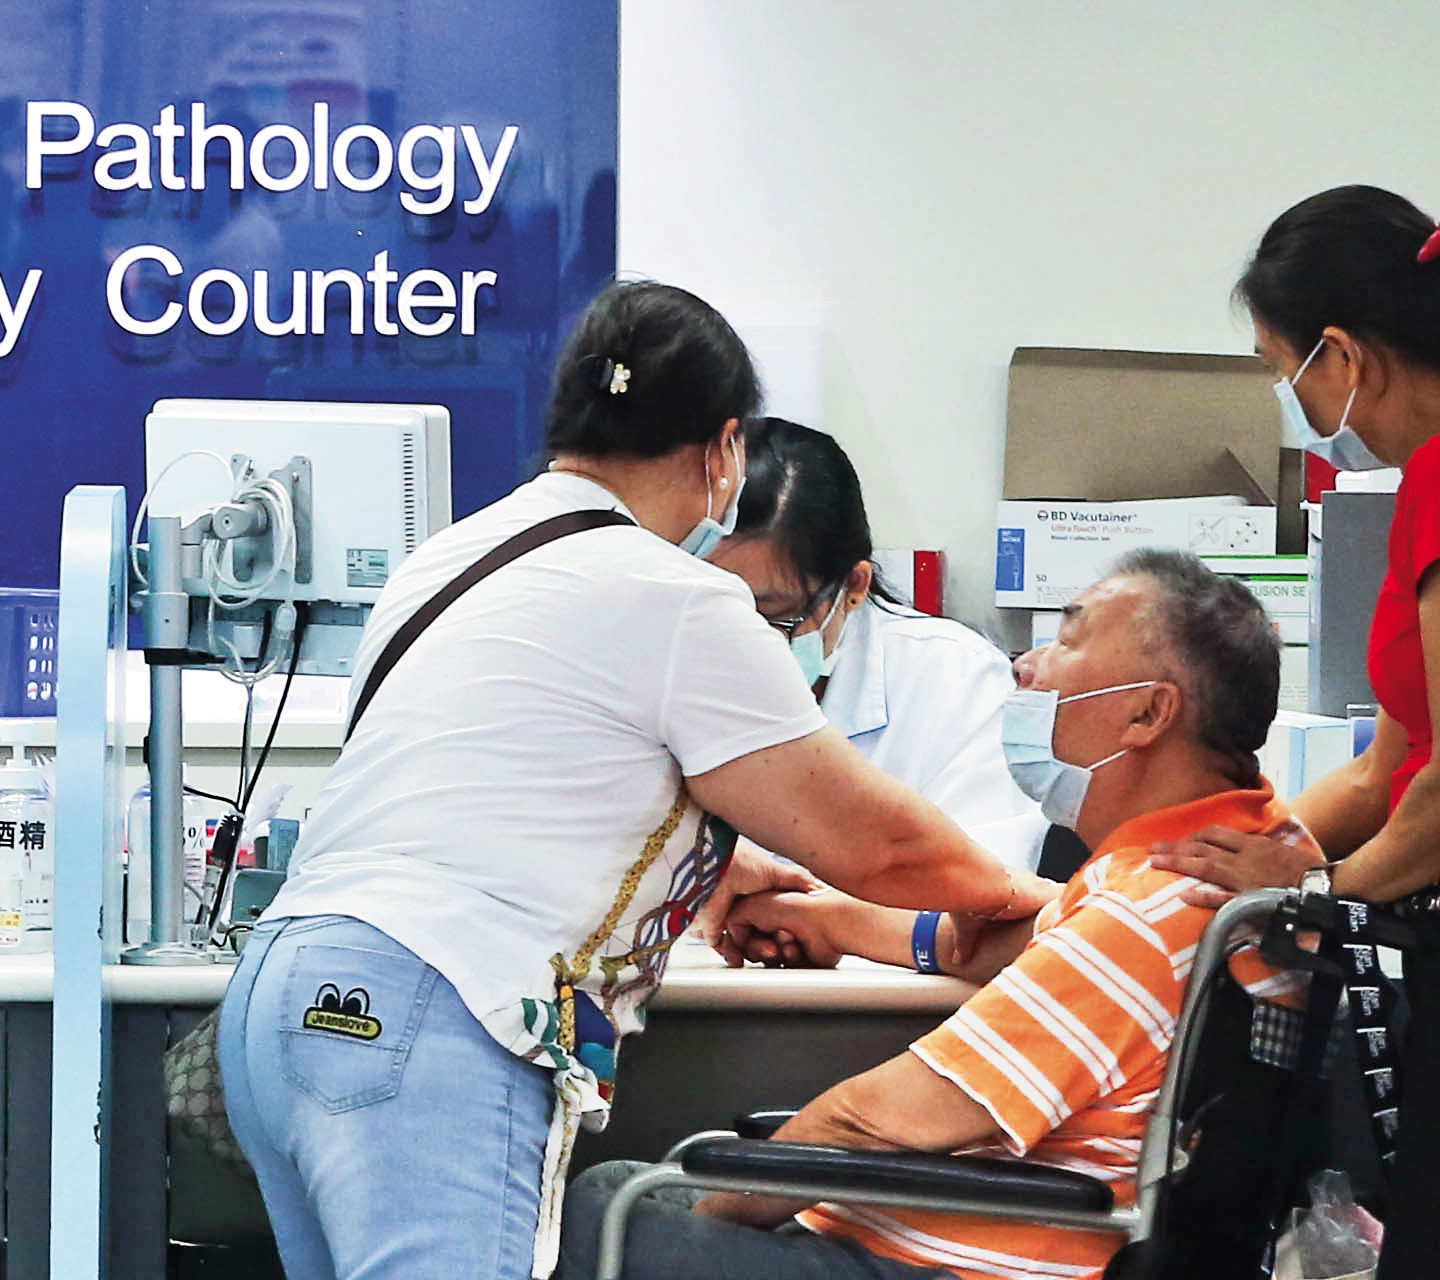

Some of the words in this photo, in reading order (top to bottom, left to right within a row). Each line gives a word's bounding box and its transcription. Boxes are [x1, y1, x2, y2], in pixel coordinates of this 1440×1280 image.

[25, 101, 519, 216] Pathology
[106, 245, 497, 337] Counter
[1051, 511, 1067, 521] BD
[1071, 511, 1133, 522] Vacutainer
